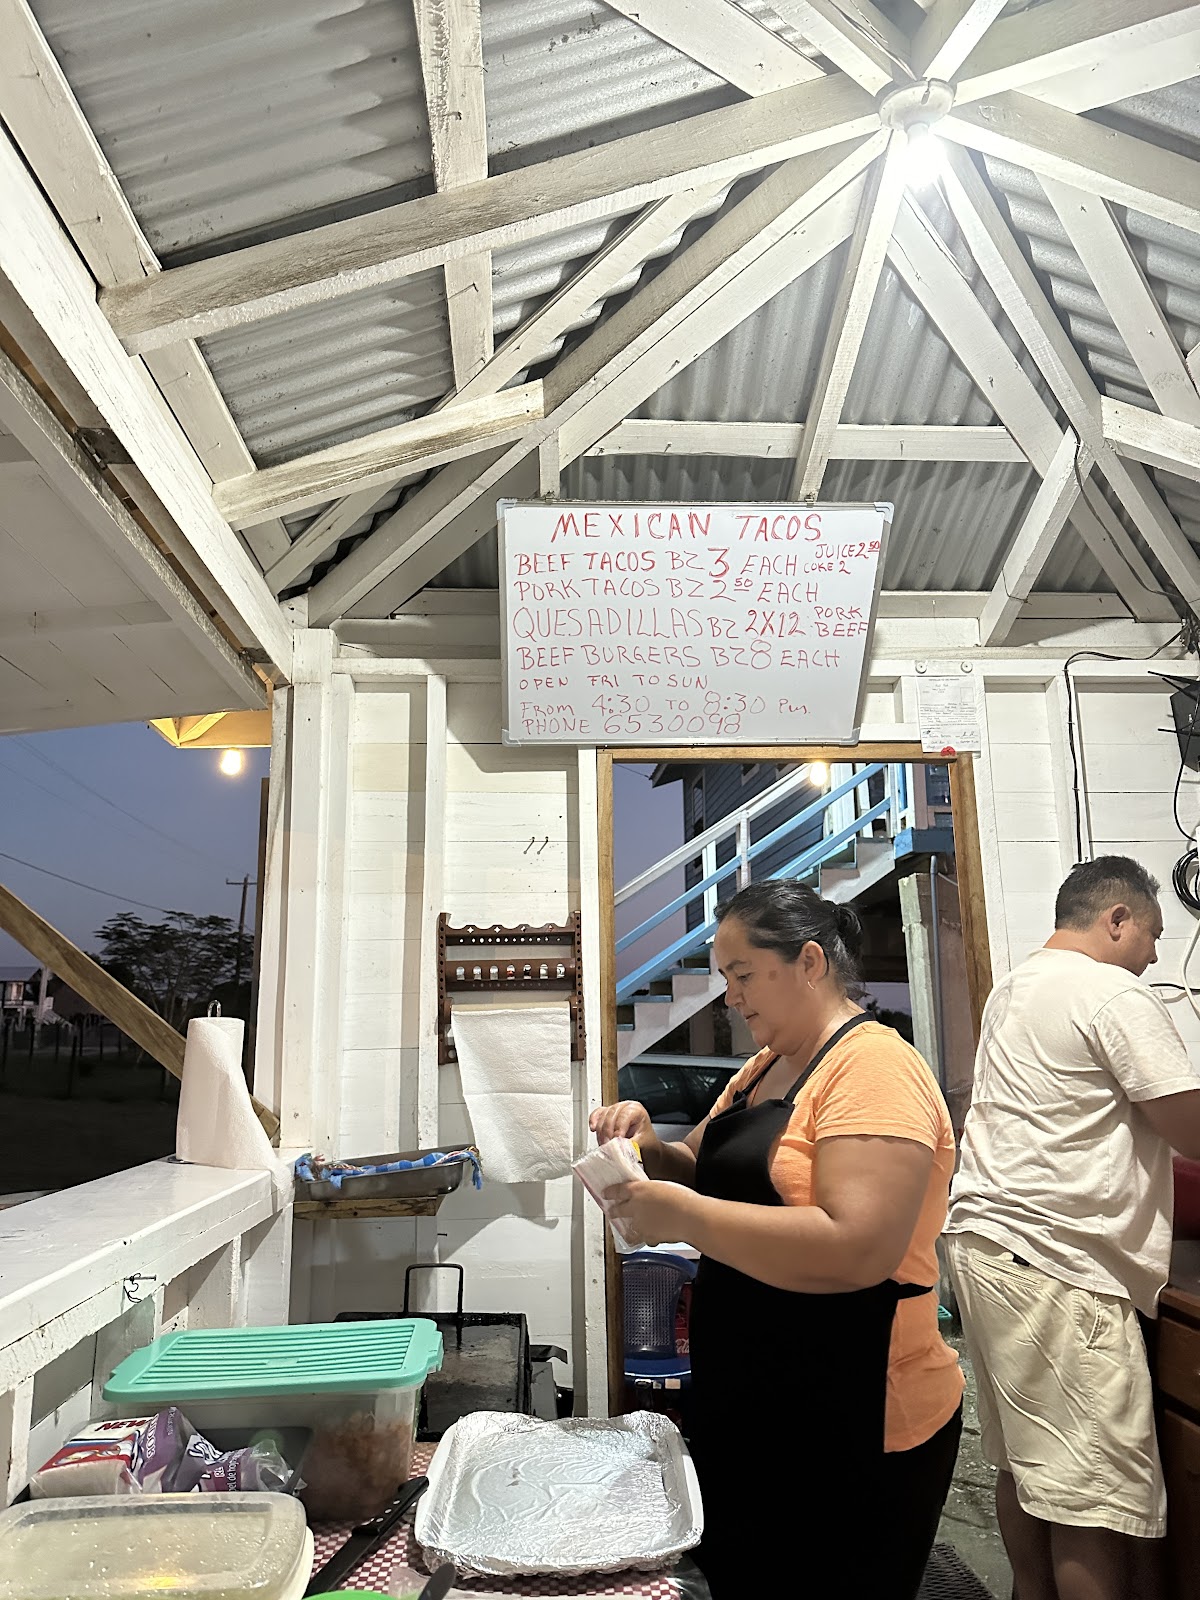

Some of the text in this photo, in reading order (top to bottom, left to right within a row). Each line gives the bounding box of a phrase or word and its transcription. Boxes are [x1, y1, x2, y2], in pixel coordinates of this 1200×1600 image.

[551, 512, 822, 543] MEXICAN TACOS
[514, 547, 798, 578] BEEF TACOS BZ 3 EACH
[815, 543, 855, 560] JUICE
[803, 560, 851, 575] COKE 2
[513, 578, 581, 601] PORK
[582, 577, 660, 597] TACOS
[666, 577, 705, 598] BZ
[757, 582, 819, 604] EACH
[512, 606, 703, 643] QUESADILLAS
[707, 616, 739, 639] BZ
[814, 605, 863, 621] PORK
[814, 622, 869, 638] BEEF
[516, 646, 575, 671] BEEF
[580, 644, 701, 668] BURGERS
[780, 648, 840, 669] EACH
[519, 674, 708, 691] OPEN FRI TO SUN
[591, 693, 650, 717] 4:30
[665, 699, 689, 711] TO
[703, 690, 766, 716] 8:30
[522, 712, 741, 735] PHONE 6530098
